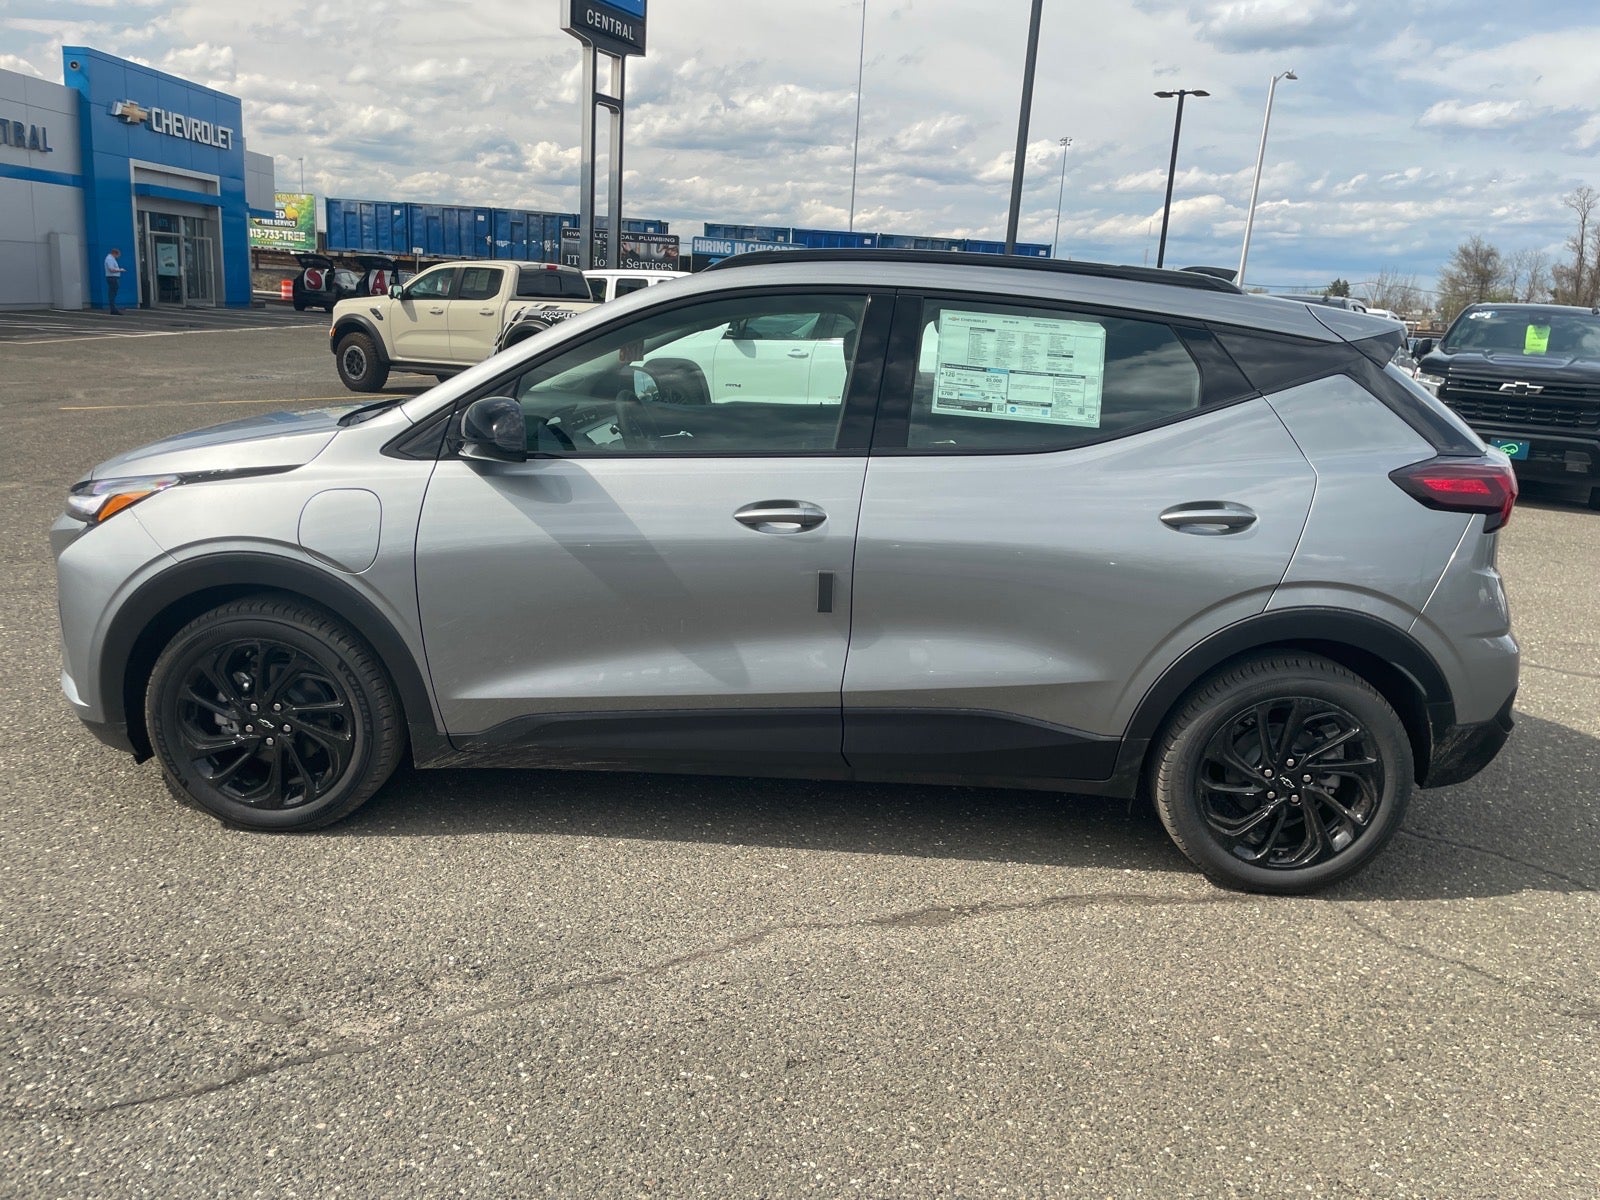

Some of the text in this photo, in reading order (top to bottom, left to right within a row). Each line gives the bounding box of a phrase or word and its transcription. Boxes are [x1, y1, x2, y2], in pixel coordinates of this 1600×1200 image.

[586, 9, 634, 40] CENTRAL
[152, 107, 234, 150] CHEVROLET
[275, 210, 285, 218] ED
[638, 235, 676, 243] PLUMBING
[694, 239, 732, 254] HIRING
[734, 242, 746, 255] IN
[626, 258, 673, 270] Services
[306, 268, 325, 290] S
[371, 269, 388, 295] A
[540, 310, 580, 321] RAPTO
